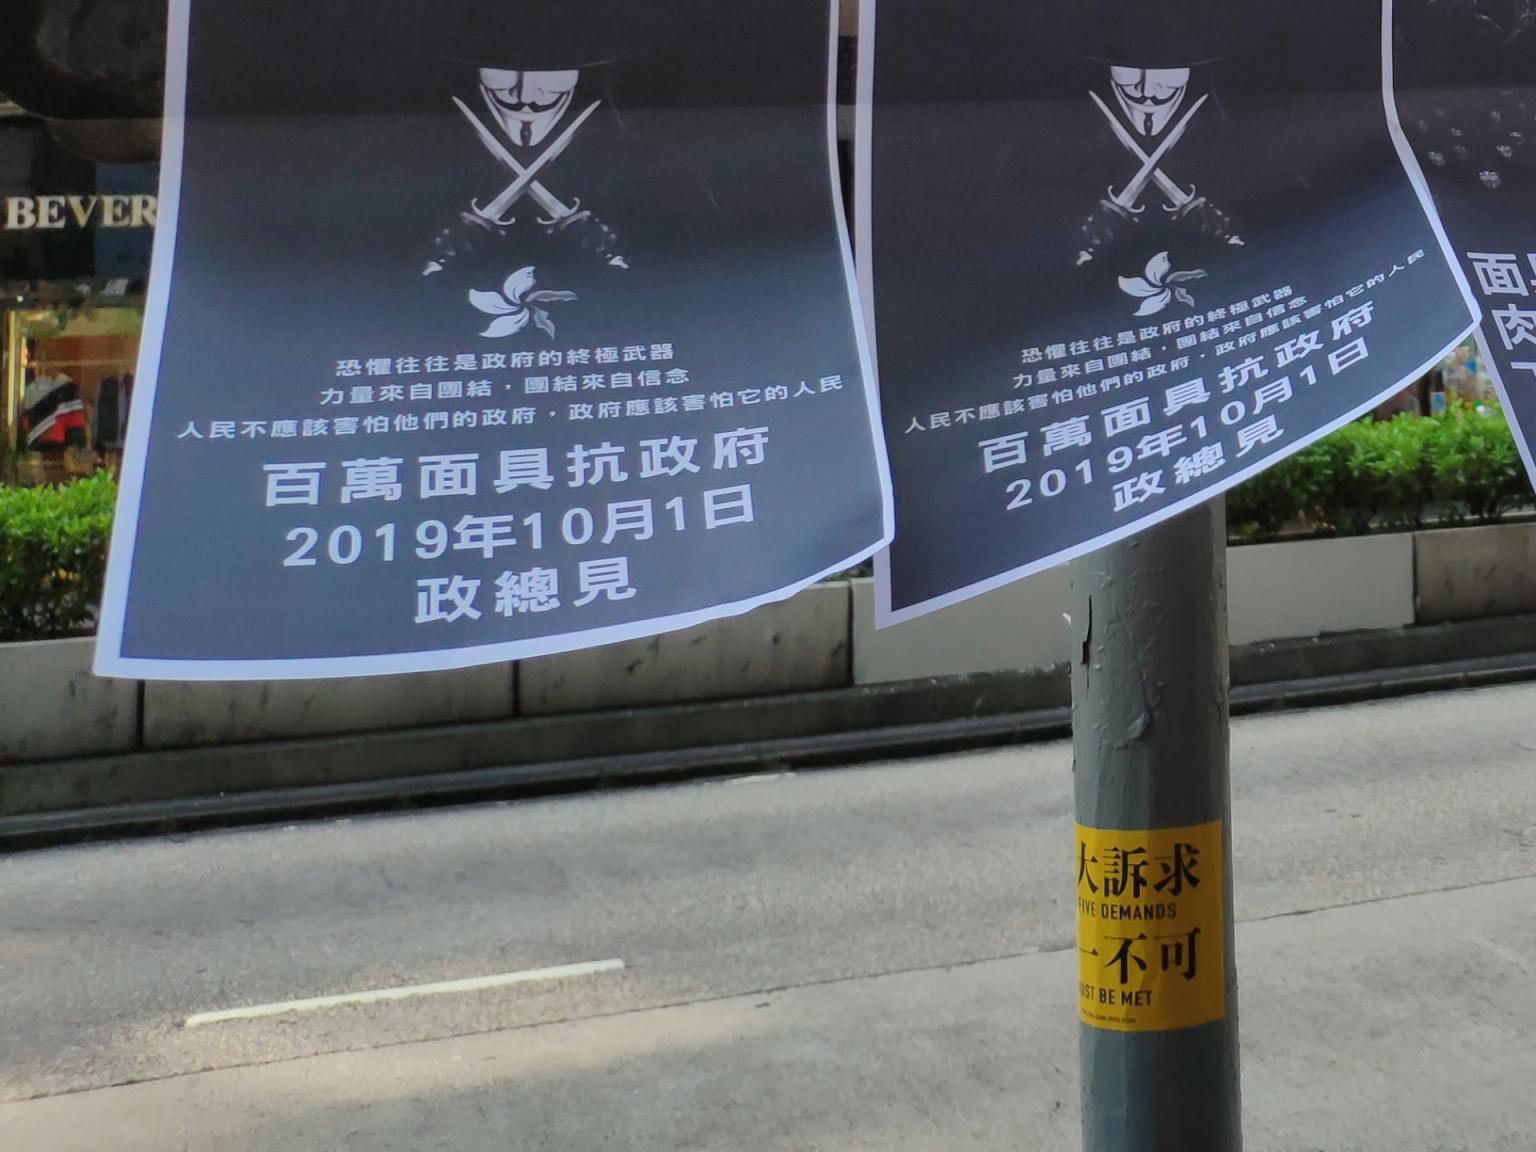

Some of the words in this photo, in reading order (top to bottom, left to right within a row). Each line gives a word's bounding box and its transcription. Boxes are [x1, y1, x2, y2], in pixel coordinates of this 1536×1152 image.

[336, 343, 675, 377] 恐懼往往是政府的終極武器
[978, 301, 1376, 474] 百萬面具抗政府
[1005, 336, 1369, 511] 2019年10月1日
[1112, 414, 1286, 513] 政總見
[263, 426, 770, 508] 百萬面具抗政府
[282, 483, 755, 568] 2019年10月1日
[415, 556, 637, 624] 政總見
[1101, 903, 1177, 921] DEMANDS
[1099, 987, 1116, 1006] BE
[1120, 990, 1153, 1008] MET
